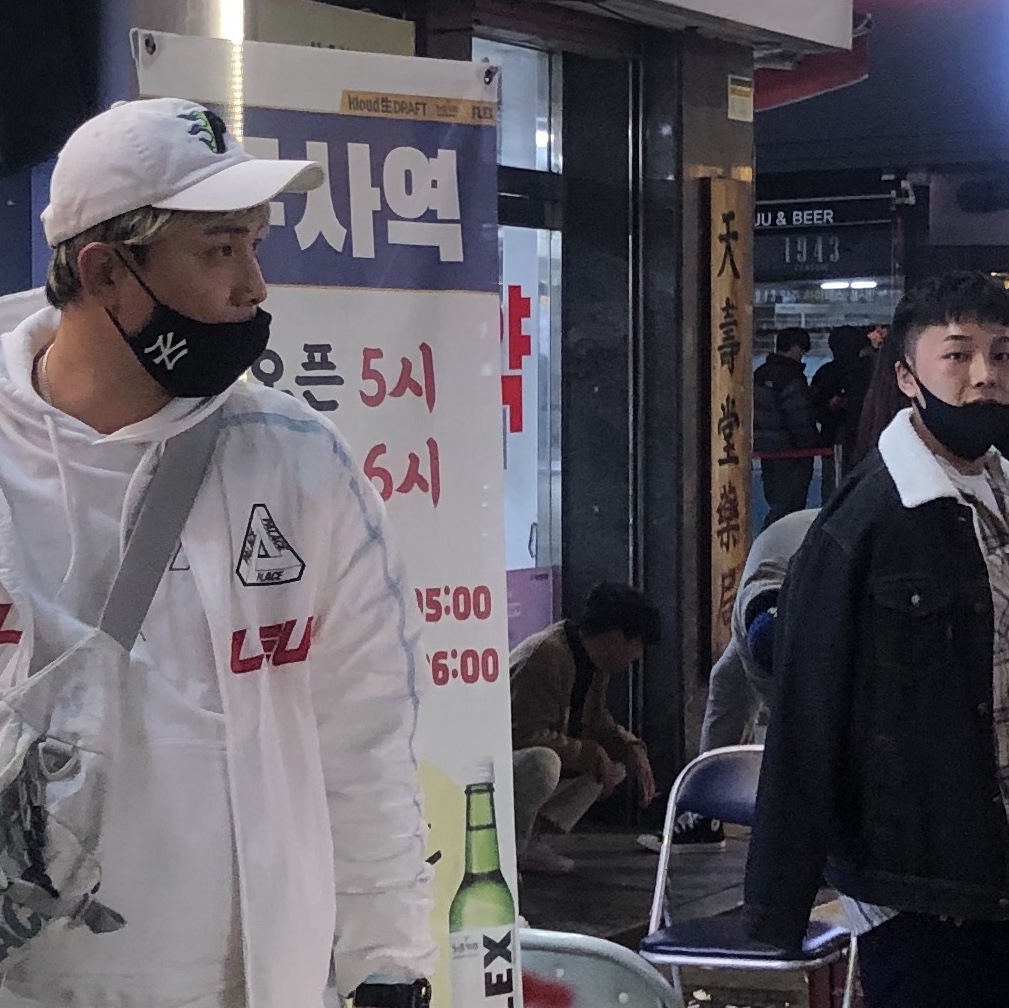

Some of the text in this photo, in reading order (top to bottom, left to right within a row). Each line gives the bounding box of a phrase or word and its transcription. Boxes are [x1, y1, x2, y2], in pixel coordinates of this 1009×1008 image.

[776, 211, 787, 226] &
[793, 209, 834, 225] BEER
[785, 236, 840, 263] 1943
[359, 342, 436, 413] 5시
[426, 647, 499, 686] 6:00
